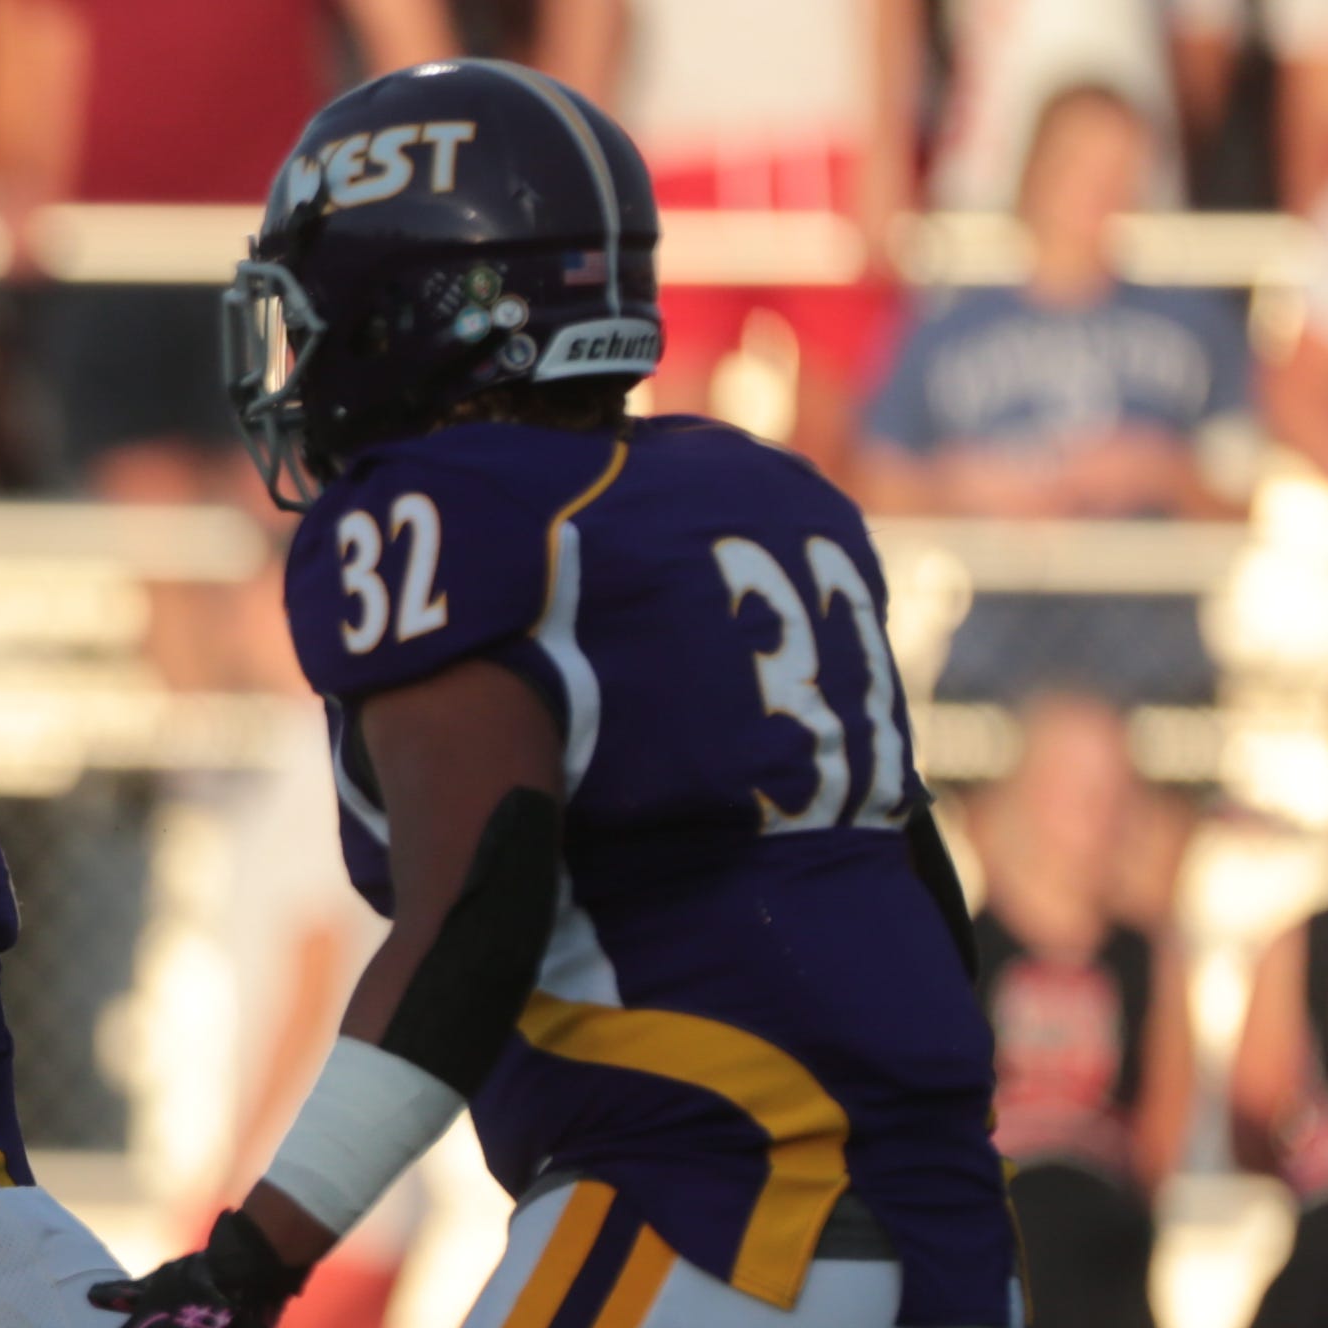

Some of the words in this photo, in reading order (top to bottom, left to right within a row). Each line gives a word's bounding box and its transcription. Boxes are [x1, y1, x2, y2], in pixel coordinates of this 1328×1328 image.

[283, 121, 477, 216] WEST
[336, 492, 449, 654] 32
[711, 536, 914, 836] 32
